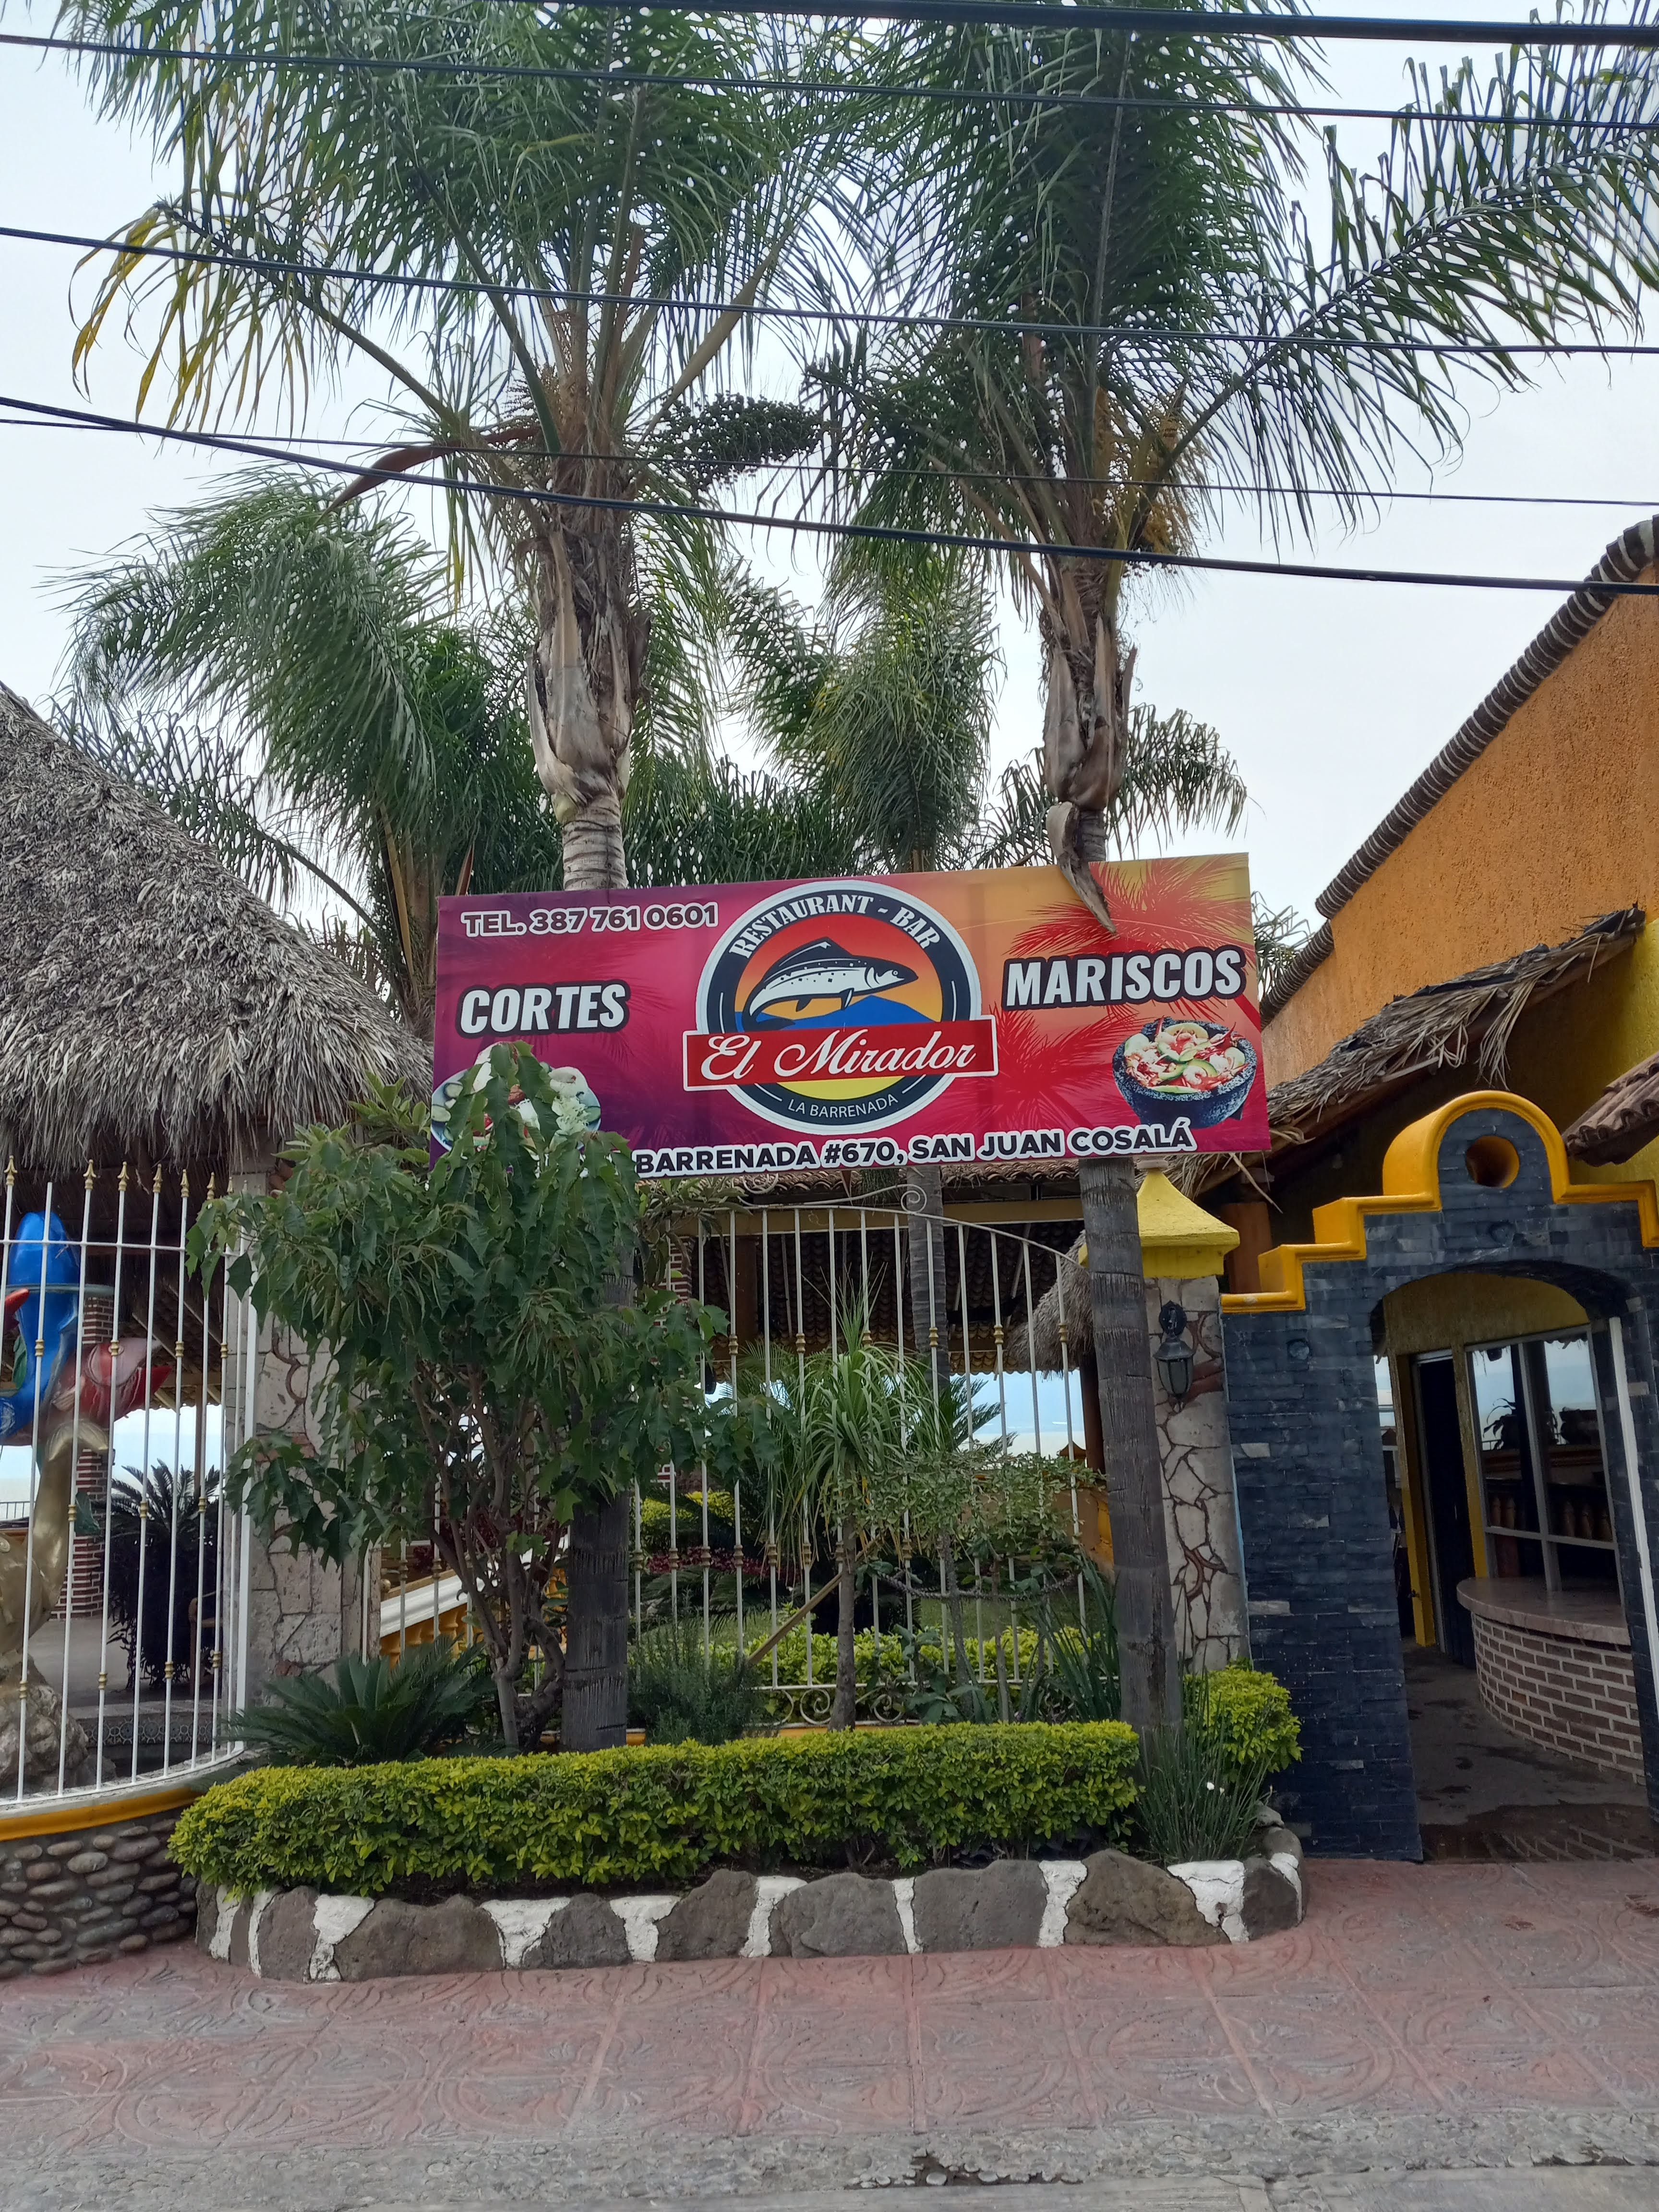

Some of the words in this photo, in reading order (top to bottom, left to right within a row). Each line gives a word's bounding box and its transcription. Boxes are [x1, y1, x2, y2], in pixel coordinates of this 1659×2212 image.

[463, 914, 523, 935] TEL.
[531, 910, 585, 932] 387
[593, 908, 639, 930] 761
[646, 905, 717, 927] 0601
[729, 894, 874, 959] RESTAURANT
[890, 907, 941, 949] BAR
[1006, 950, 1241, 1007] MARISCOS
[460, 984, 626, 1034] CORTES
[701, 1036, 761, 1080] El
[774, 1029, 976, 1077] Mirador
[788, 1099, 805, 1114] LA
[810, 1094, 898, 1118] BARRENADA
[636, 1145, 816, 1173] BARRENADA
[824, 1141, 904, 1165] #670,
[912, 1137, 971, 1159] SAN
[981, 1131, 1060, 1156] JUAN
[1071, 1120, 1193, 1152] COSALÁ
